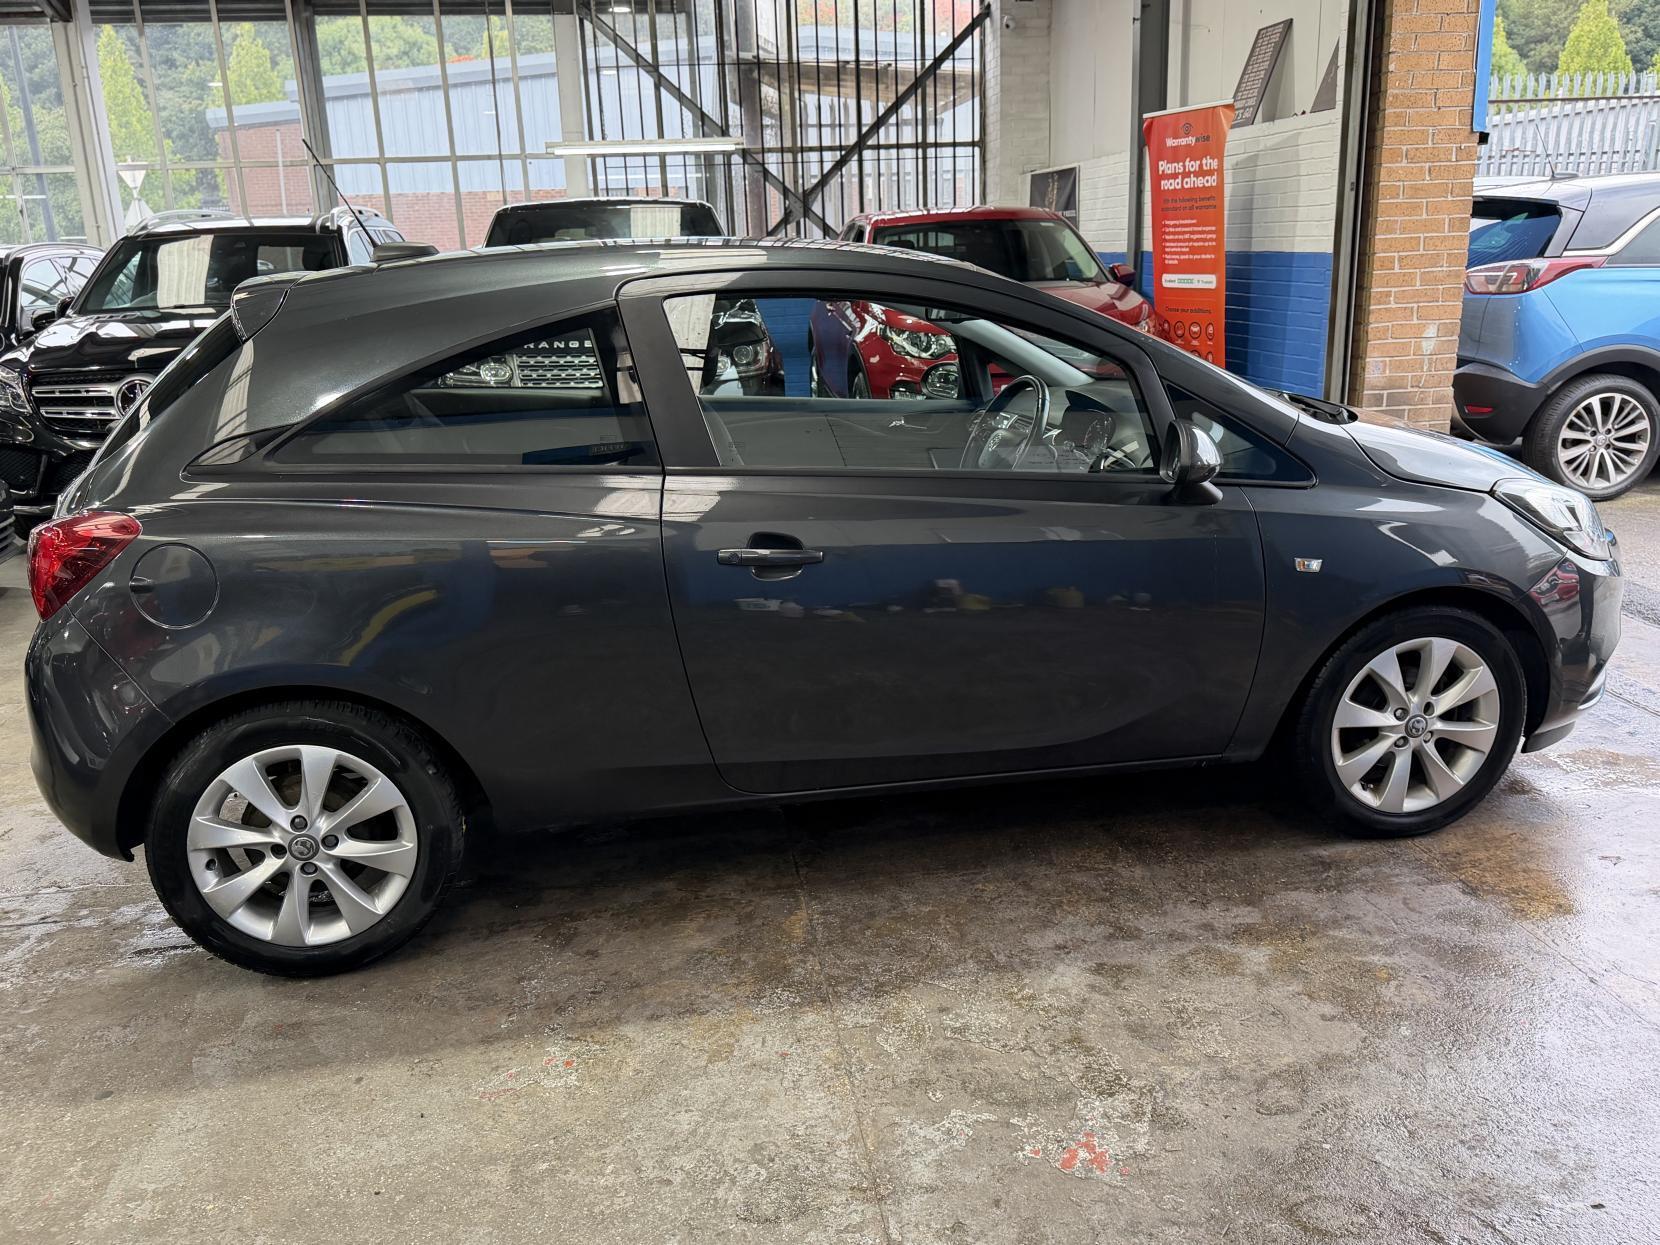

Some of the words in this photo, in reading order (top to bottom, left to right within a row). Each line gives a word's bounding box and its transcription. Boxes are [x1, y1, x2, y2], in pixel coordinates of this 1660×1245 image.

[1165, 134, 1210, 147] Warrantywise
[1158, 160, 1183, 175] Plans
[1185, 157, 1200, 172] for
[1202, 155, 1218, 170] the
[1161, 175, 1182, 190] road
[1183, 172, 1217, 189] ahead
